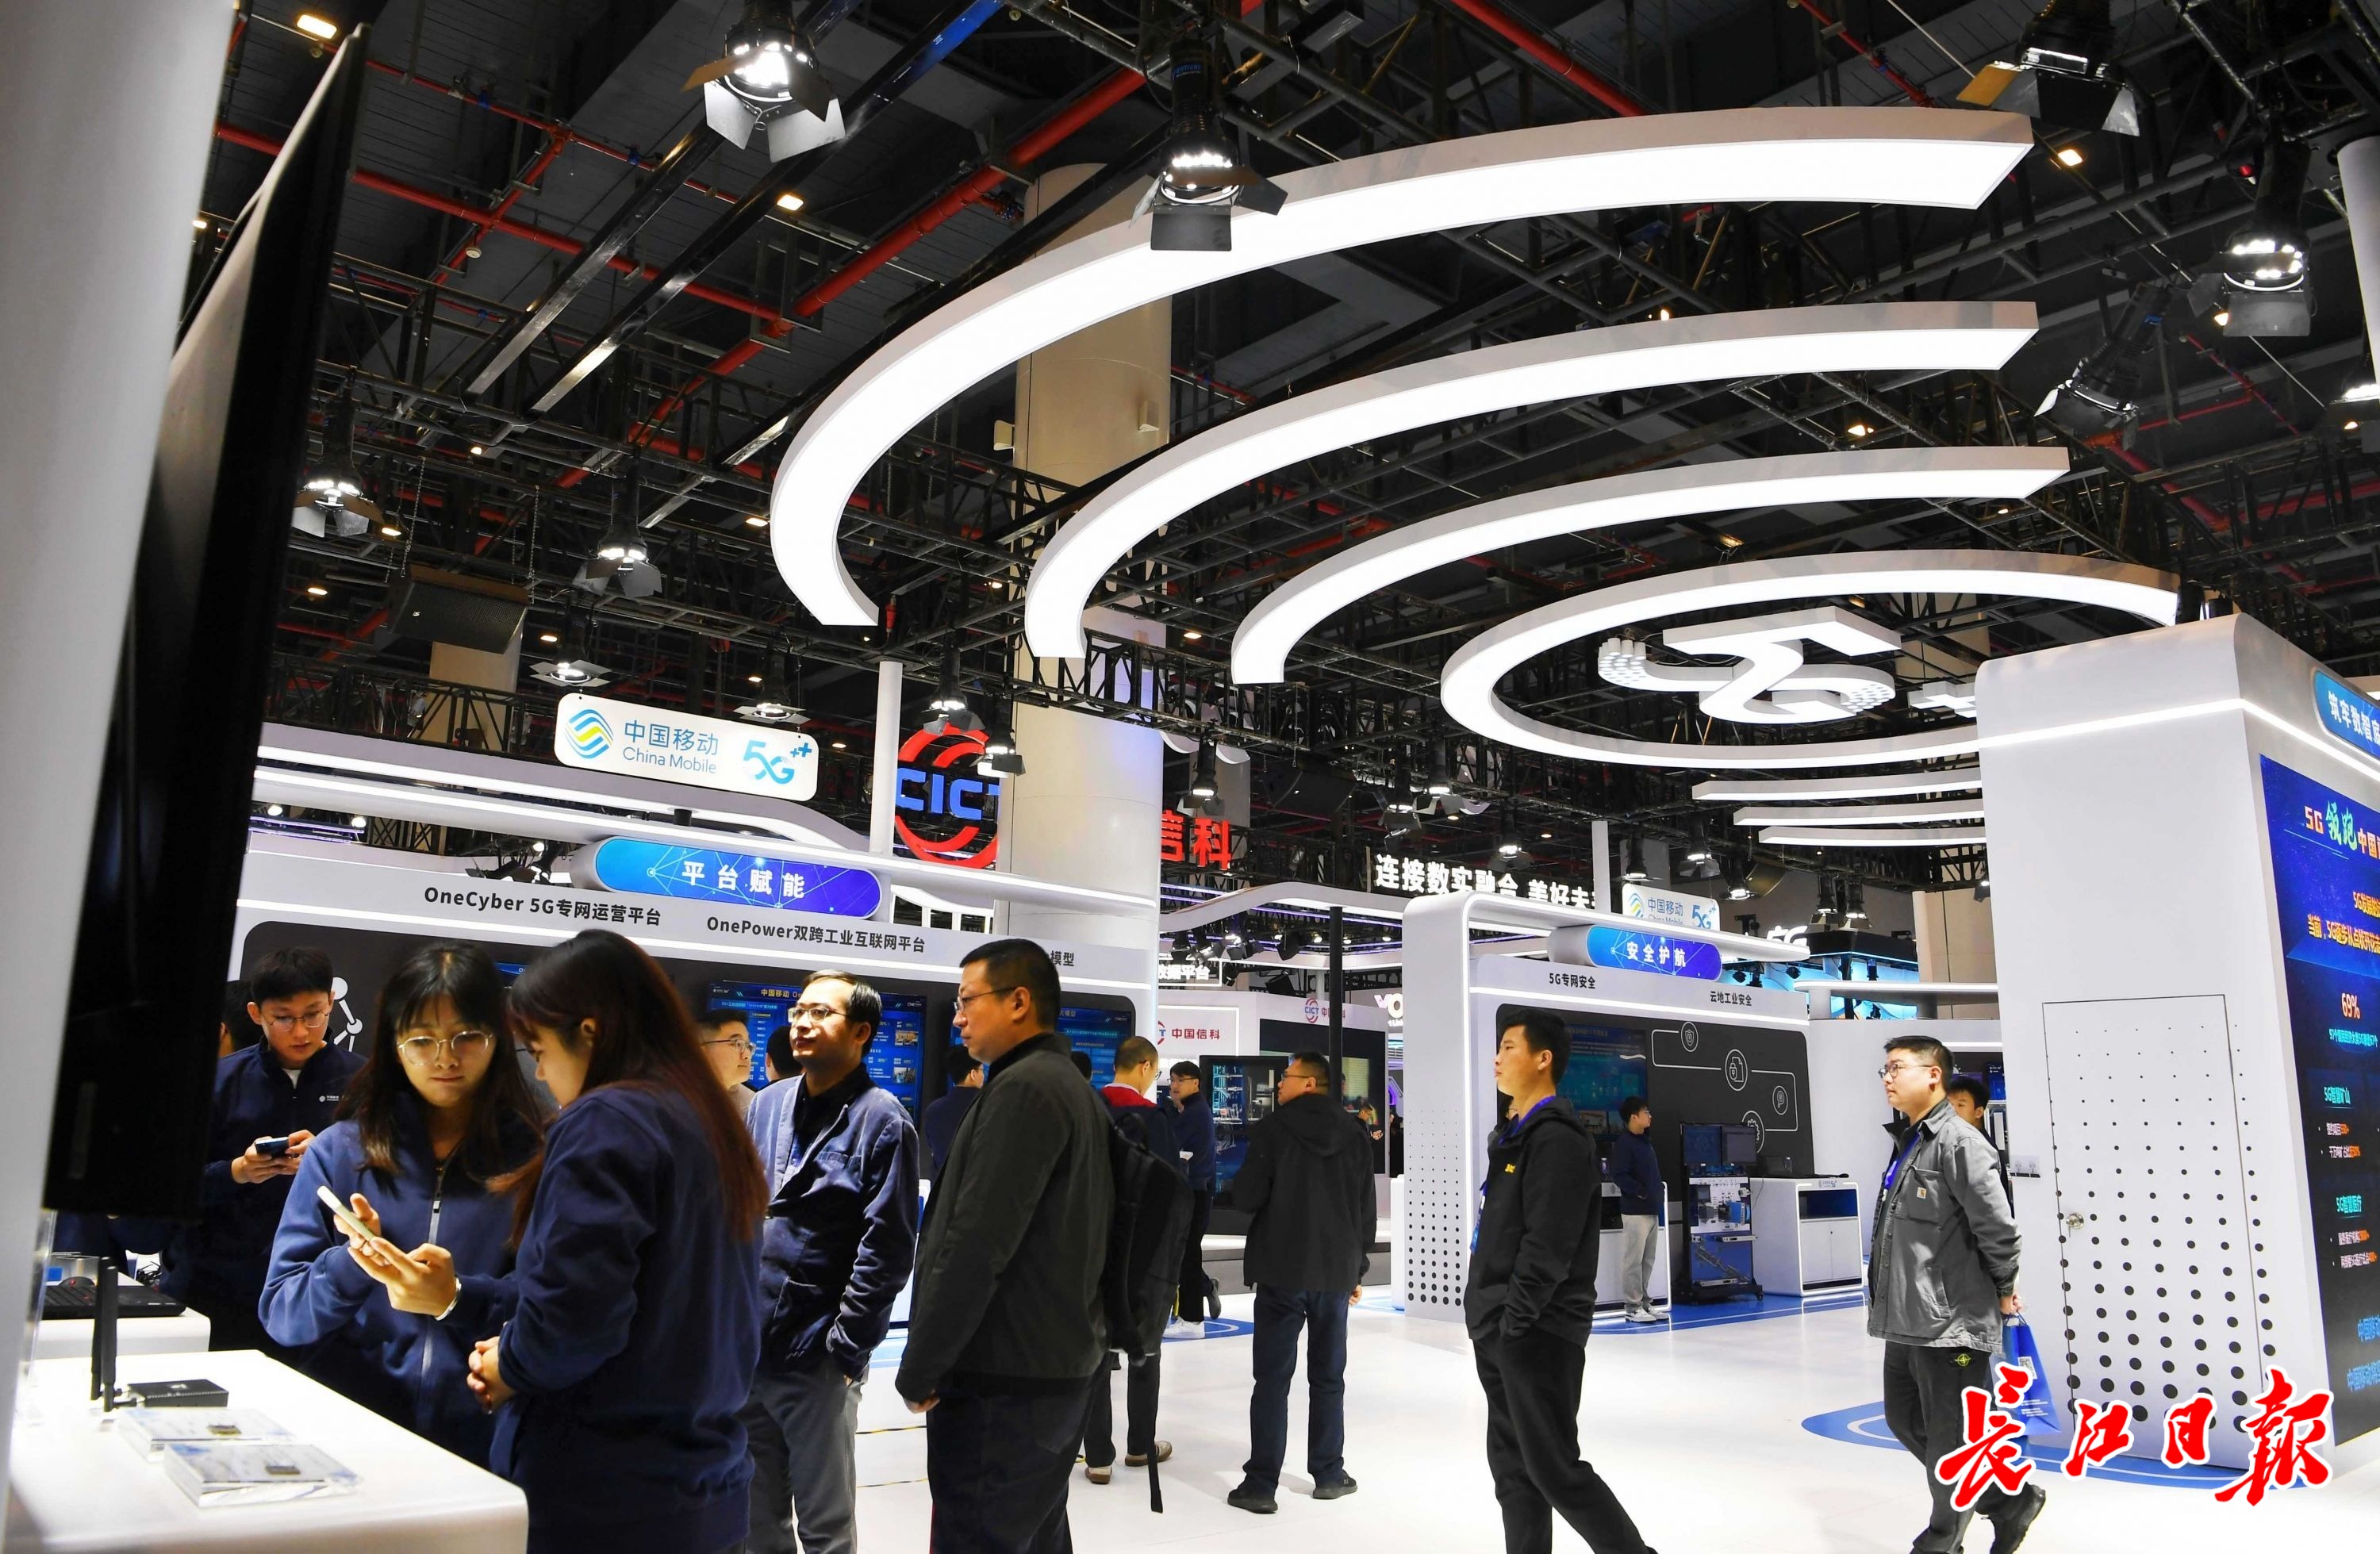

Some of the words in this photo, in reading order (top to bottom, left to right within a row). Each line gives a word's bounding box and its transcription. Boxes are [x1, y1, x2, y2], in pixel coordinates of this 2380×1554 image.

[624, 719, 719, 755] 中国移动
[623, 746, 666, 766] China
[669, 754, 717, 774] Mobile
[681, 861, 805, 899] 平台赋能
[1375, 853, 1518, 896] 连接数实融合
[424, 887, 524, 911] OneCyber
[529, 898, 662, 926] 5G专网运营平台
[1647, 897, 1683, 916] 中国移动
[707, 916, 926, 953] OnePower双跨工业互联网平台
[1626, 941, 1687, 967] 安全护航
[1549, 973, 1596, 990] 5G专网安全
[1710, 991, 1752, 1007] 云地工业安全
[2341, 992, 2361, 1019] 69%
[1172, 1028, 1220, 1040] 中国信科
